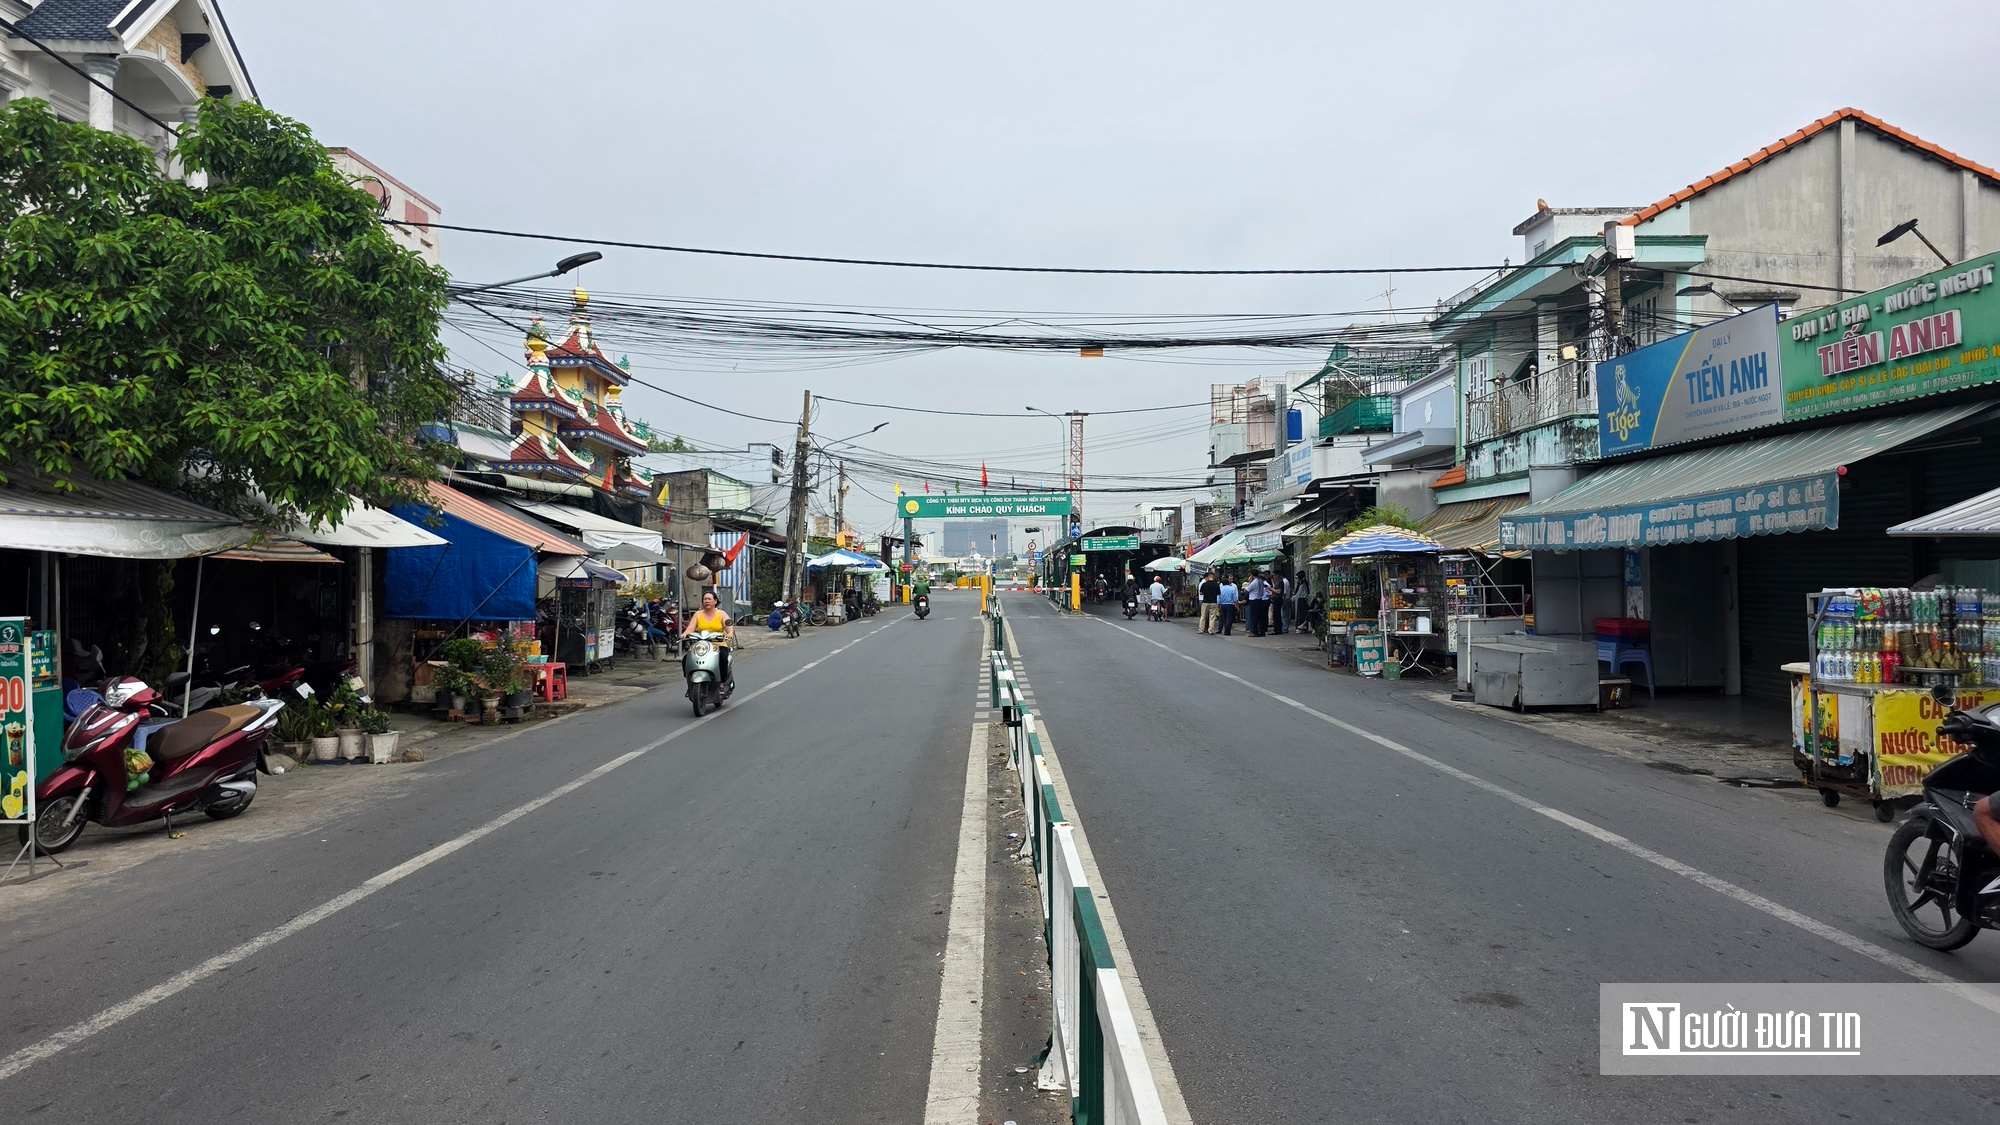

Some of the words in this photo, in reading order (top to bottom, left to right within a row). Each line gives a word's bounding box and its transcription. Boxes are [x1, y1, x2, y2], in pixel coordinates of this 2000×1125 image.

[1792, 319, 1818, 343] ĐẠI
[1820, 308, 1838, 335] LÝ
[1841, 304, 1871, 328] BIA
[1884, 280, 1937, 315] NƯỚC
[1939, 263, 1994, 298] NGỌT
[1712, 337, 1723, 350] ĐẠI
[1723, 333, 1732, 346] LÝ
[1818, 322, 1884, 377] TIẾN
[1888, 309, 1962, 361] ANH
[1685, 353, 1725, 405] TIẾN
[1729, 351, 1769, 396] ANH
[1869, 373, 1876, 385] &
[1890, 363, 1908, 380] CÁC
[1911, 360, 1933, 376] LOẠI
[1934, 355, 1951, 372] BIA
[1960, 346, 1989, 366] NƯỚC
[1932, 376, 1949, 389] 0786
[1949, 372, 1962, 385] 559
[1962, 370, 1974, 383] 677
[1732, 400, 1740, 409] BIA
[1607, 404, 1641, 442] Tiger
[946, 504, 966, 515] KÍNH
[969, 504, 993, 514] CHÀO
[996, 502, 1013, 515] QUÝ
[1016, 503, 1046, 514] KHÁCH
[1012, 496, 1028, 504] THANH
[1052, 495, 1067, 503] PHONG
[1648, 502, 1694, 524] CHUYÊN
[1696, 499, 1733, 518] CUNG
[1735, 489, 1765, 512] CẤP
[1787, 488, 1802, 505] &
[1516, 522, 1533, 549] ĐẠI
[1533, 517, 1546, 545] LÝ
[1546, 520, 1566, 545] BIA
[1573, 512, 1607, 545] NƯỚC
[1608, 513, 1642, 549] NGỌT
[1359, 661, 1370, 672] LÁ
[1362, 649, 1379, 660] BÒ
[1881, 727, 1931, 756] NƯỚC
